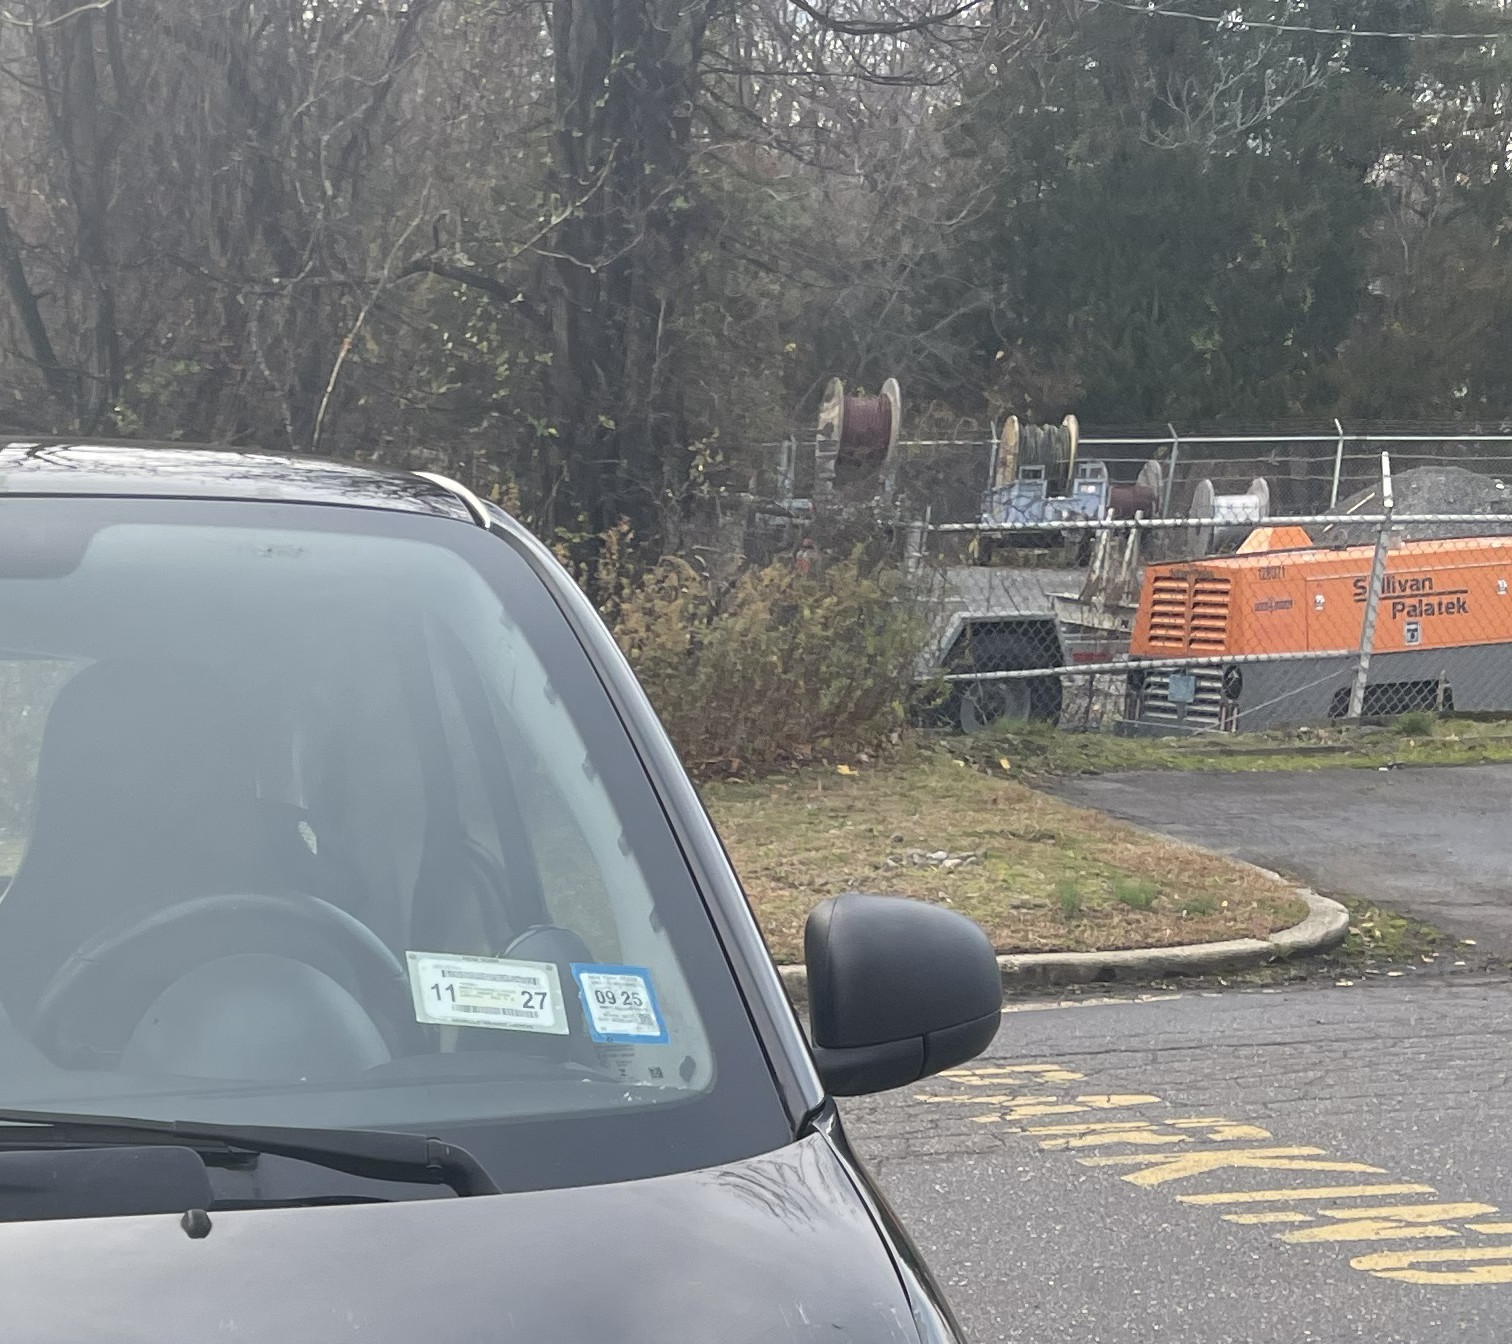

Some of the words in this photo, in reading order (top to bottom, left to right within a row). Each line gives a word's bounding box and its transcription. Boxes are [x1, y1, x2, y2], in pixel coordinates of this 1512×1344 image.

[1353, 575, 1434, 597] Sllivan
[1391, 597, 1469, 620] Palatek
[431, 983, 456, 1003] 11
[521, 990, 547, 1010] 27
[594, 990, 617, 1005] 09
[621, 991, 643, 1007] 25
